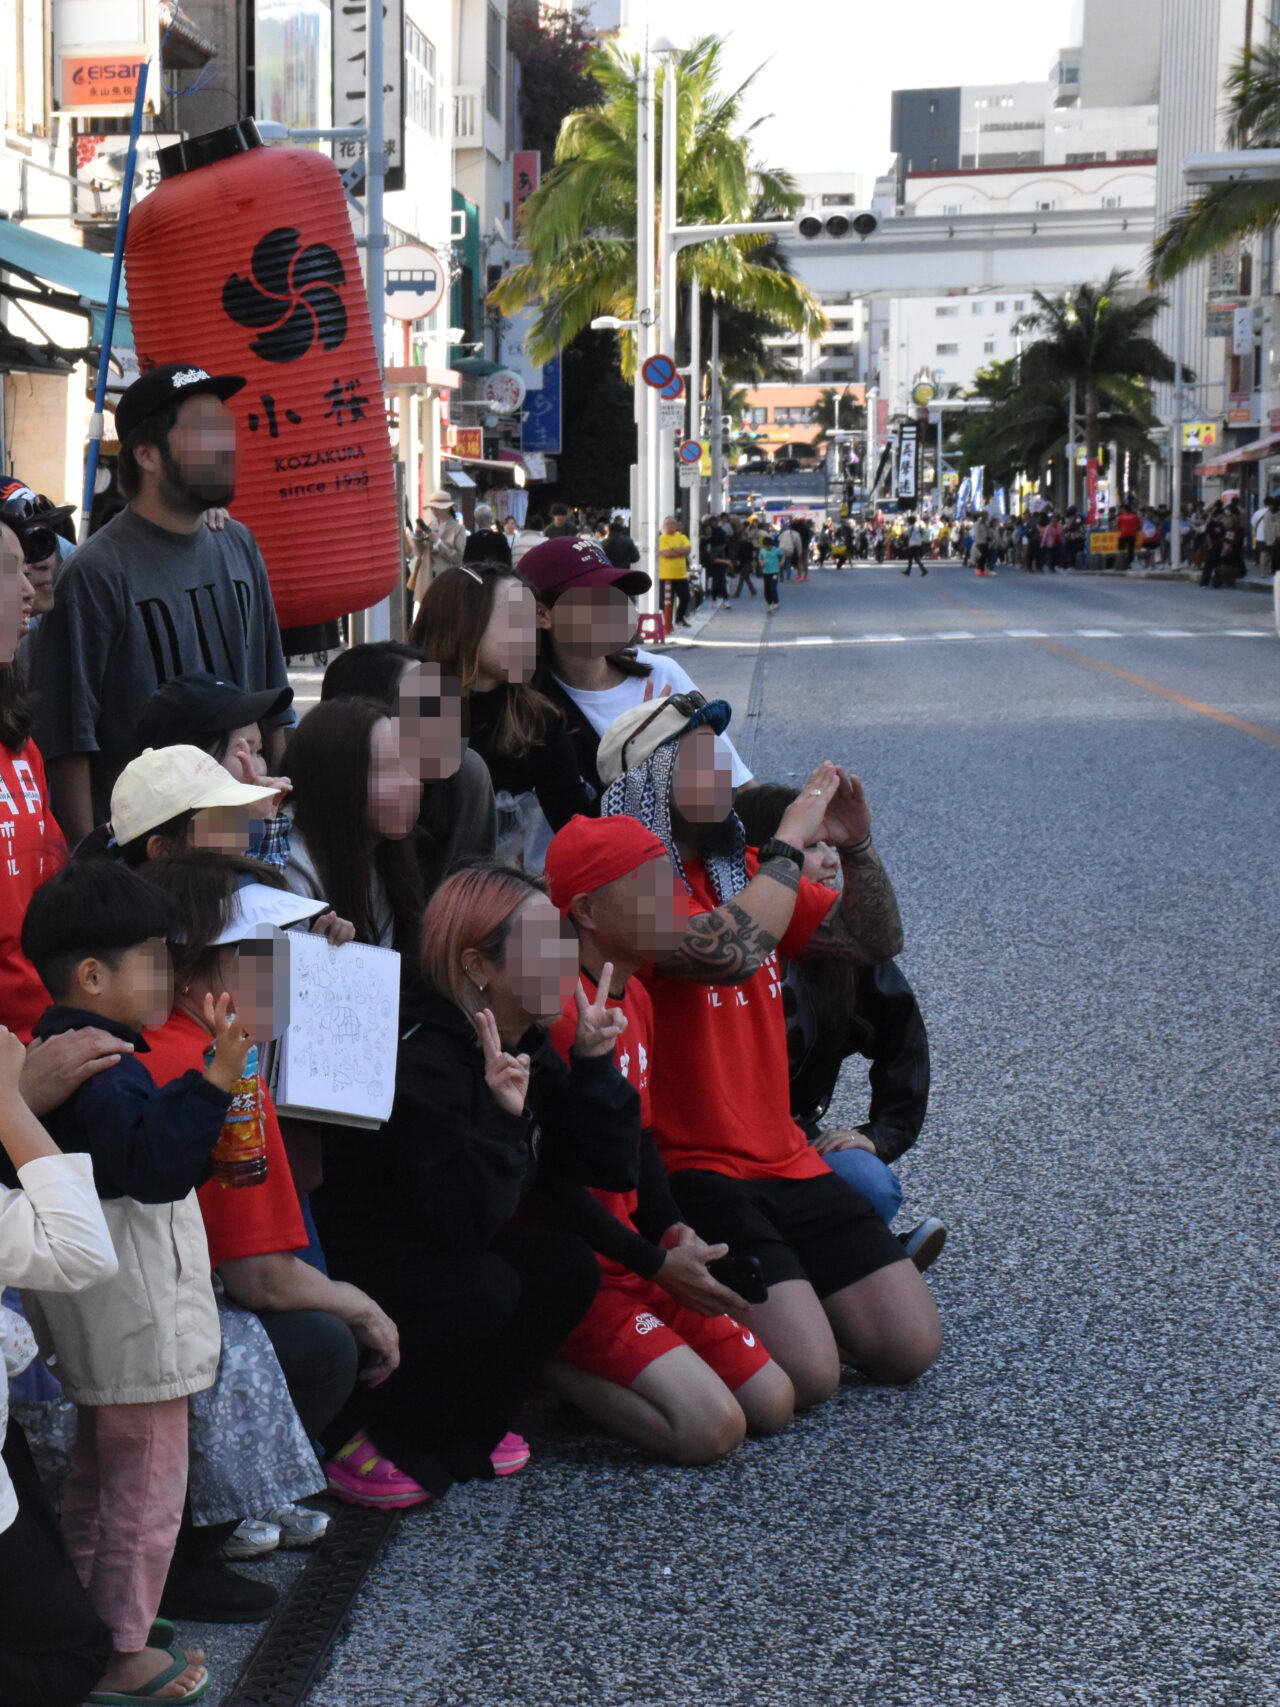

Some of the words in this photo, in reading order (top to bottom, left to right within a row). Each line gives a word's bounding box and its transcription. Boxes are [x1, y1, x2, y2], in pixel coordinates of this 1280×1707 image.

[89, 85, 138, 97] 永山免税
[248, 378, 370, 438] 小桜
[275, 445, 366, 472] KOZAKURA
[280, 481, 326, 498] since
[335, 470, 370, 491] 1955
